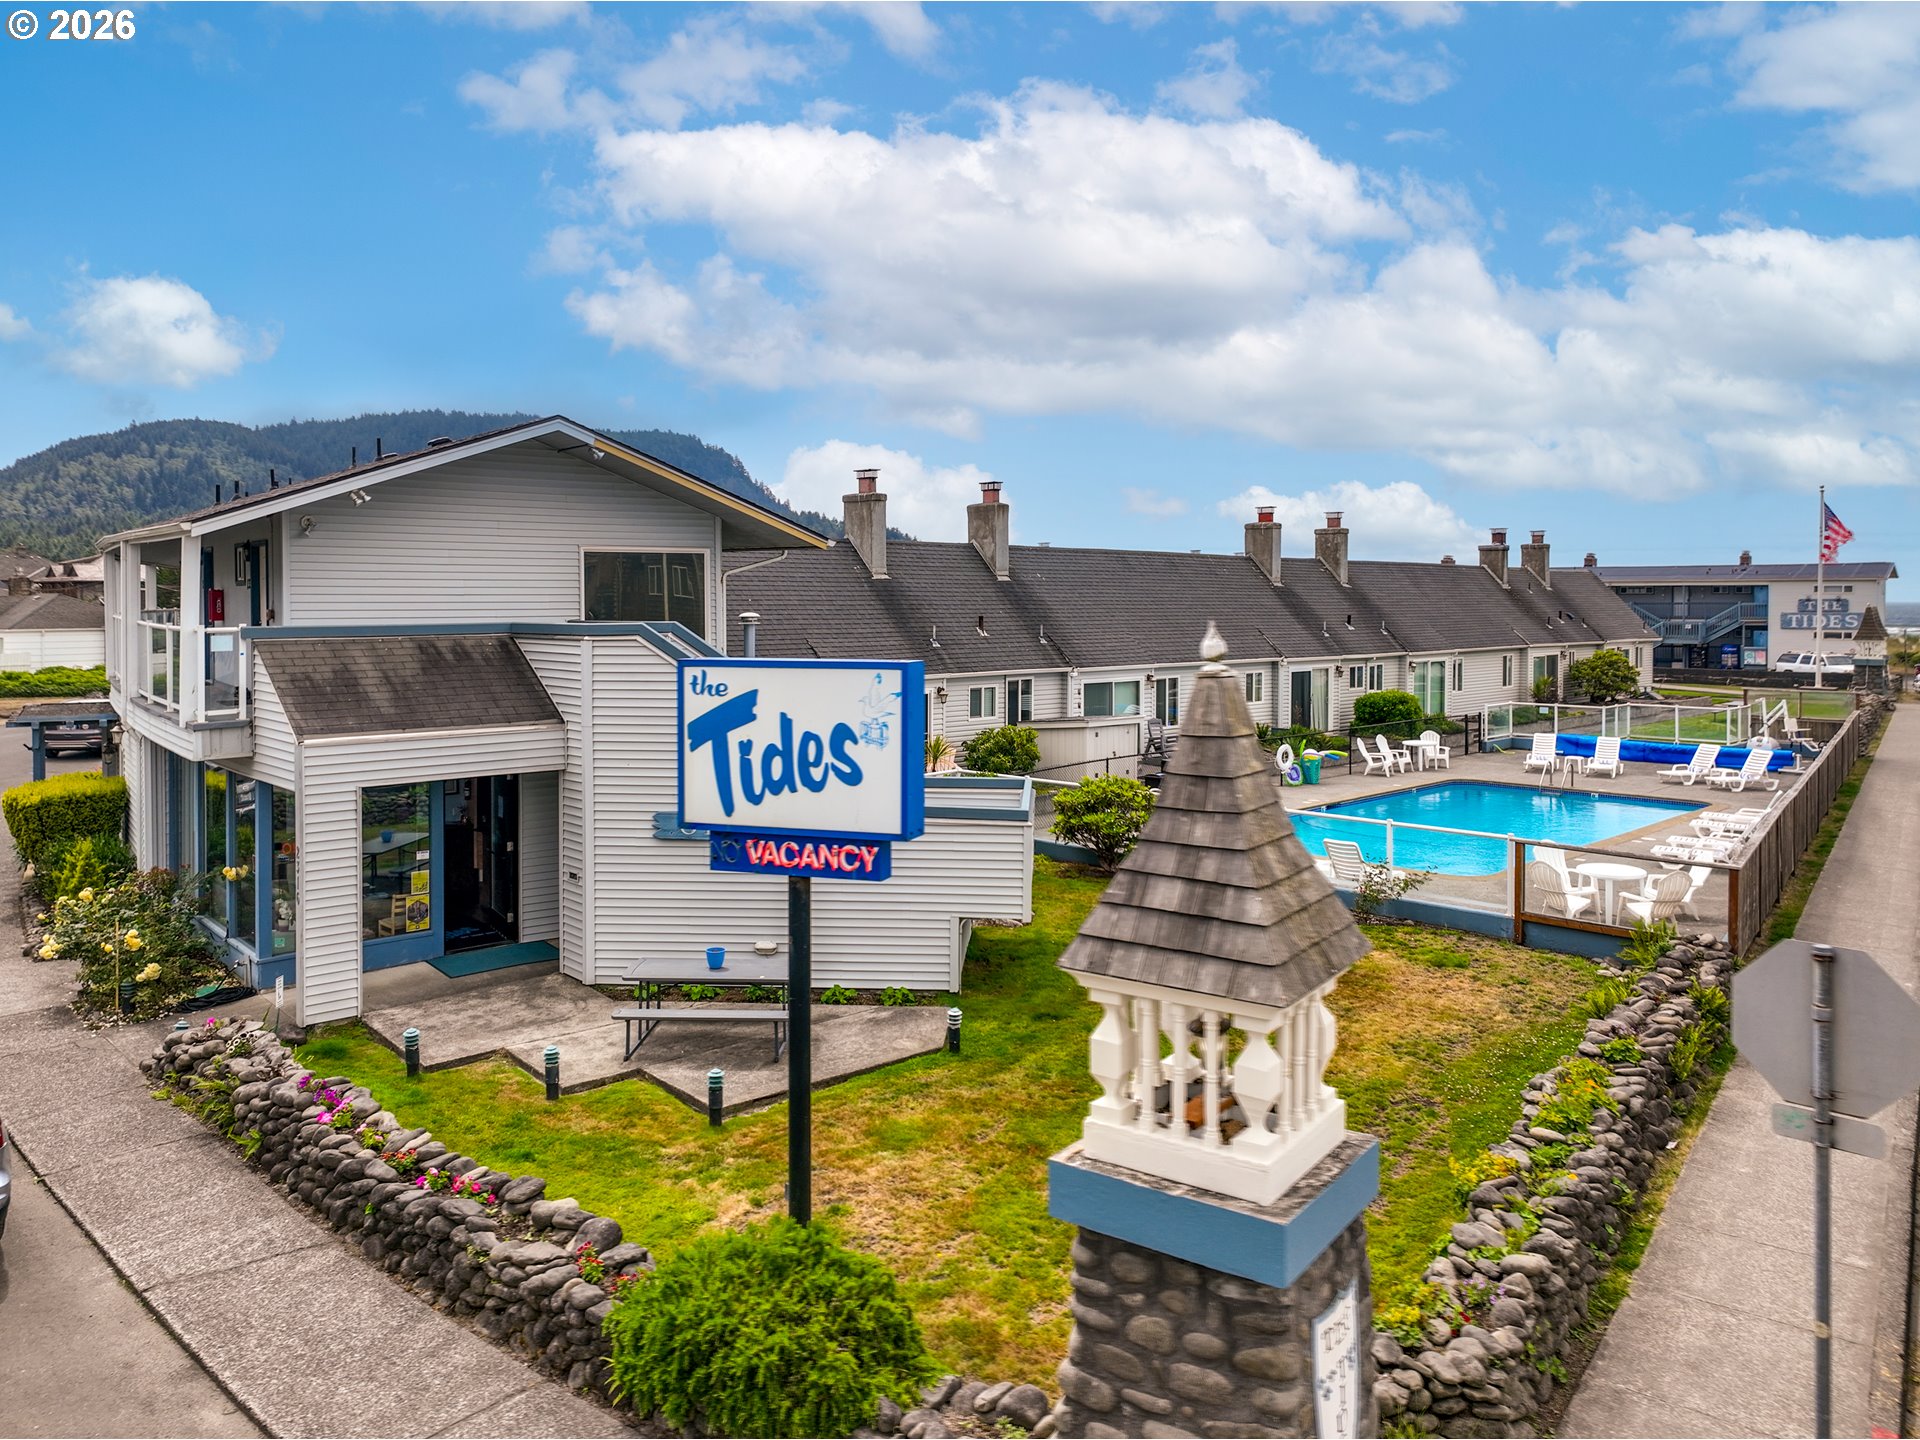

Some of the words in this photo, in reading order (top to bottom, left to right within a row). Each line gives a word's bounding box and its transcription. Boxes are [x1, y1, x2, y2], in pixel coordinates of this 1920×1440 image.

[1787, 614, 1858, 628] TIDES
[689, 669, 729, 697] the
[687, 689, 863, 817] Tides
[745, 839, 879, 872] VACANCY
